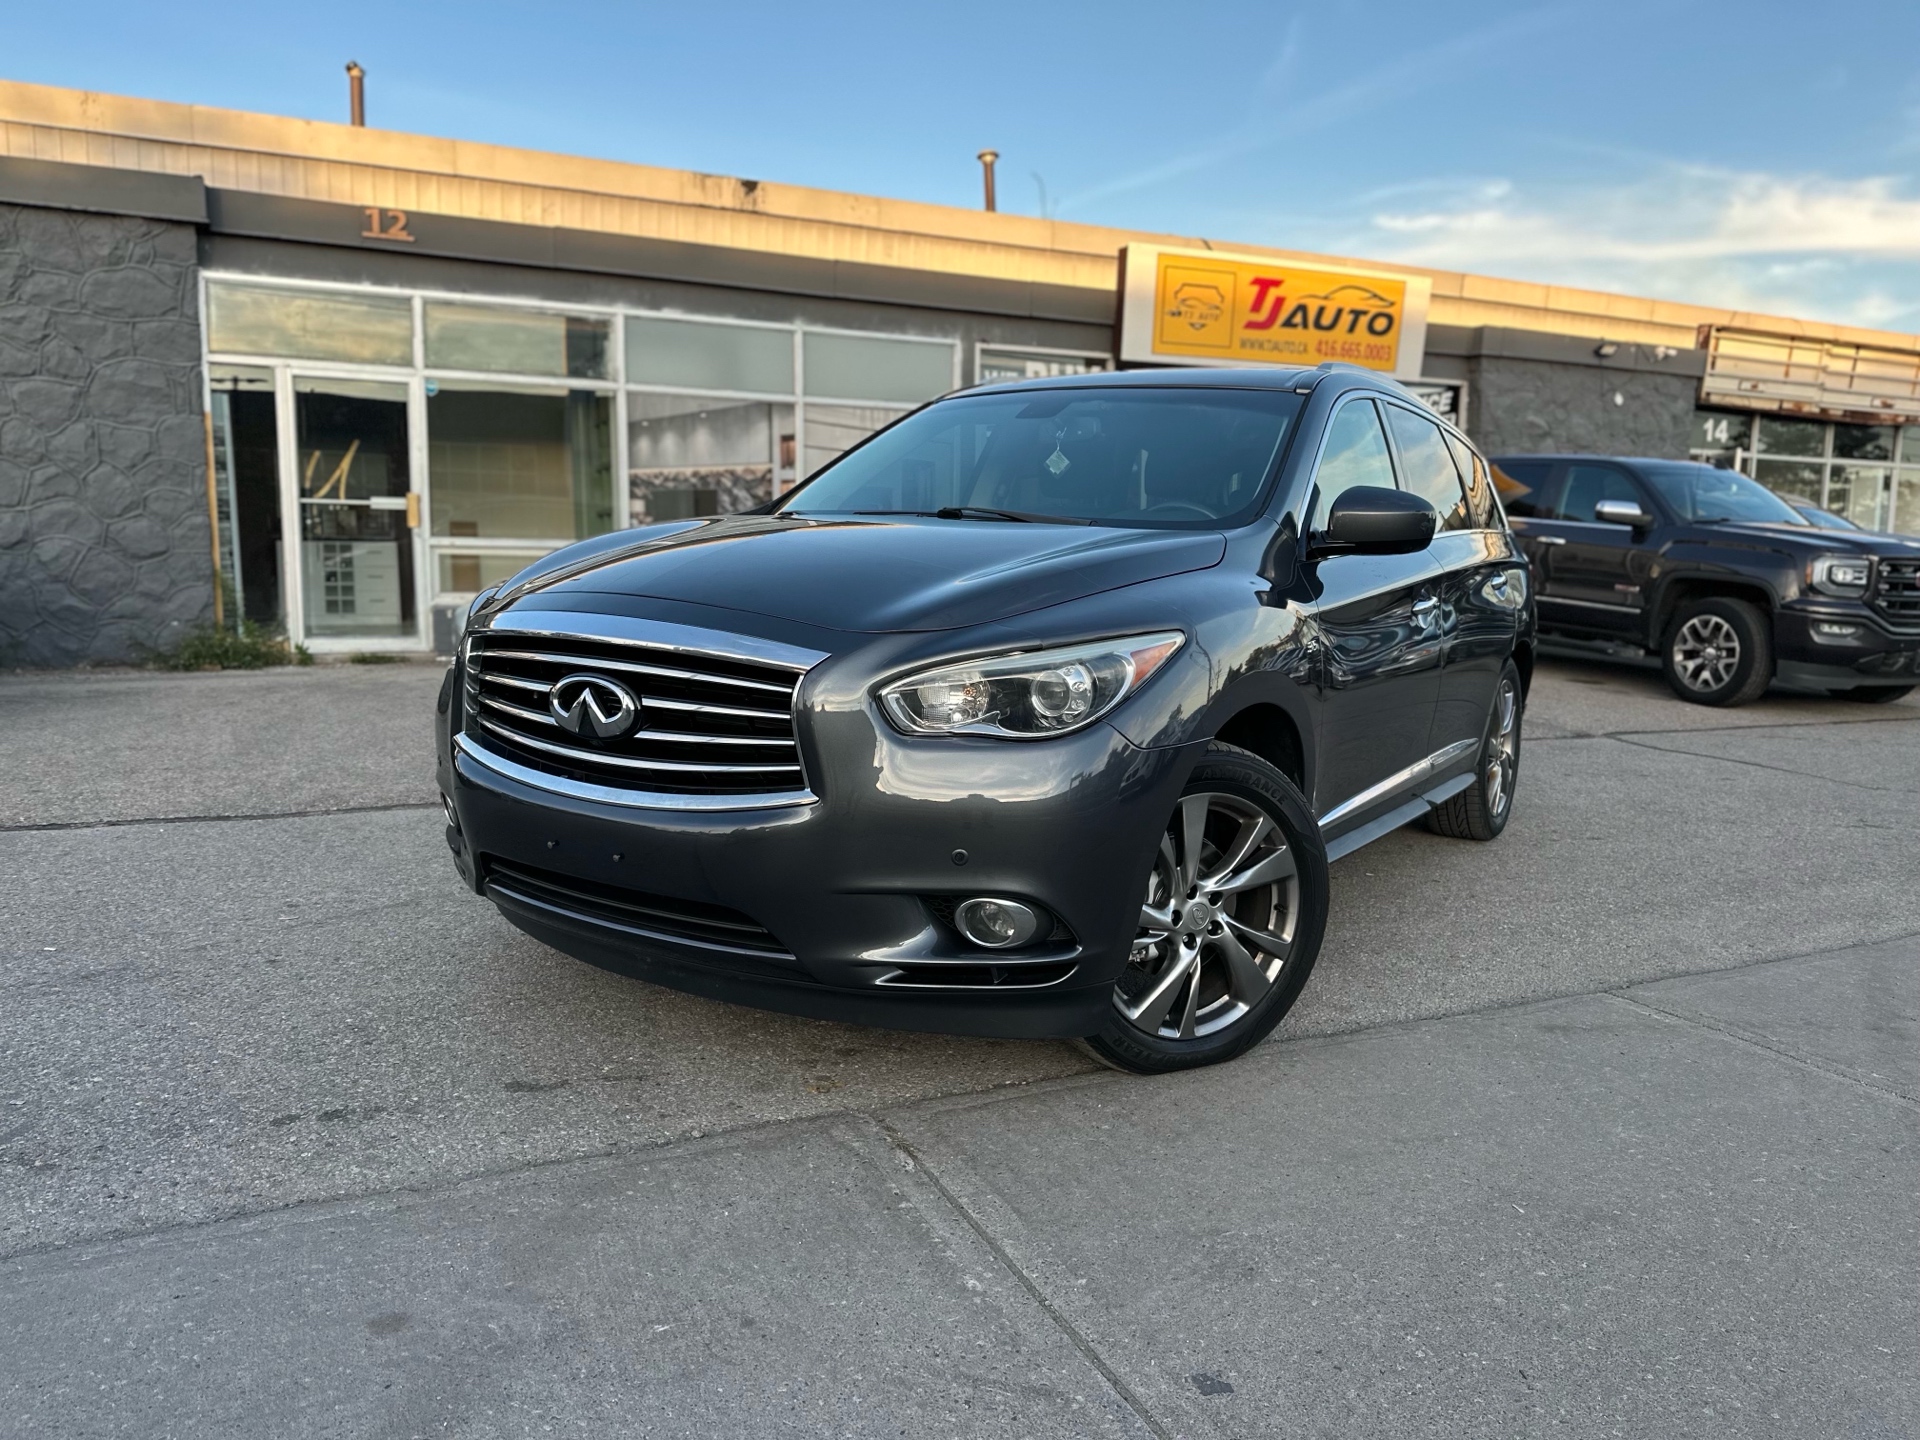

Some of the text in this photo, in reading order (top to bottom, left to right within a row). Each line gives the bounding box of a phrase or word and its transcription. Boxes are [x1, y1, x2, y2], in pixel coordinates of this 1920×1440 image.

[364, 207, 409, 237] 12
[1280, 303, 1396, 337] AUTO
[1703, 418, 1729, 443] 14
